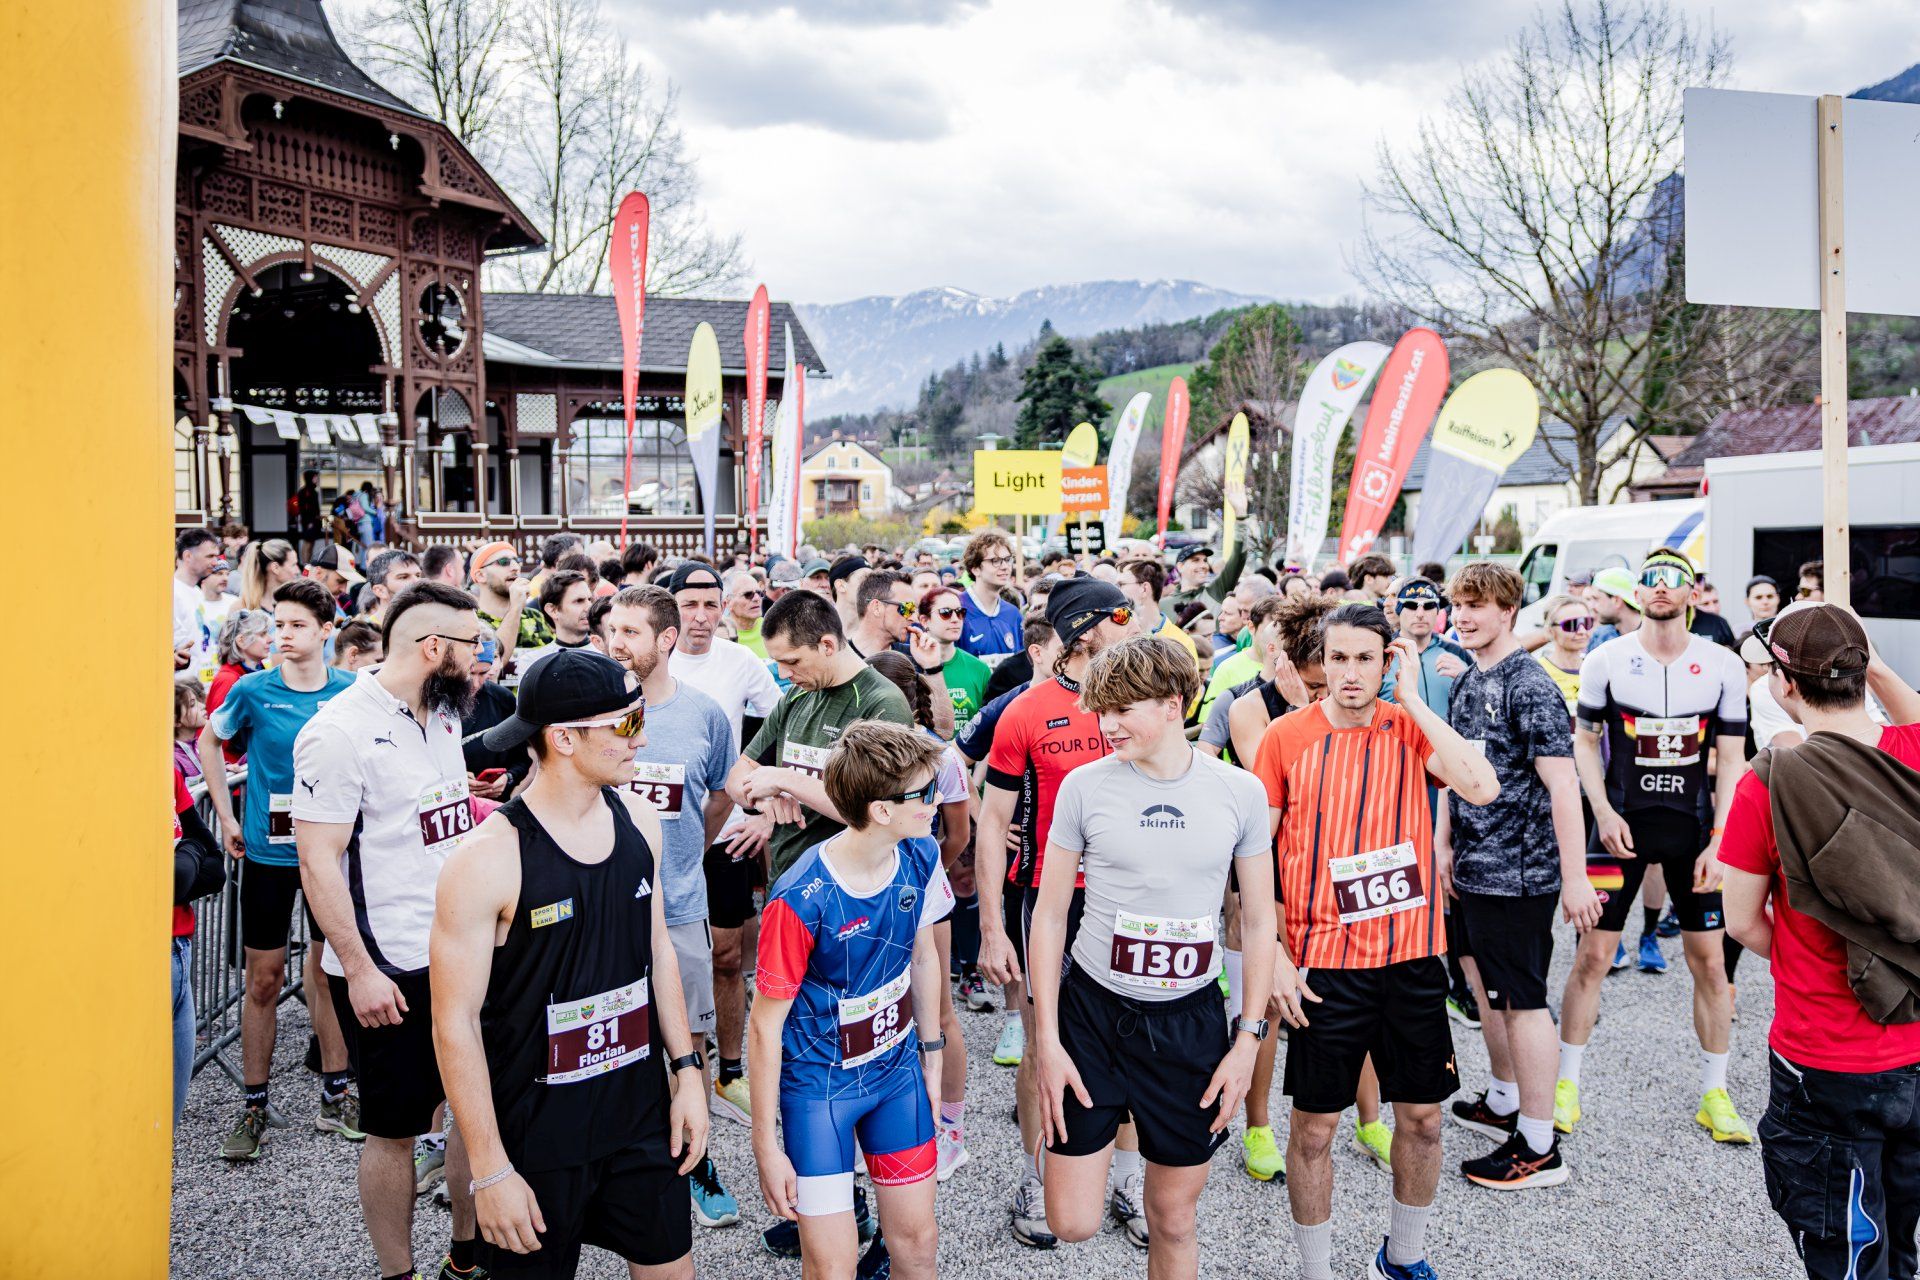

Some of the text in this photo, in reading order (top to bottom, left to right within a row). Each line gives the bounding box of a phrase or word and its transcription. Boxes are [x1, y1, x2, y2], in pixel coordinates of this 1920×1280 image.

[1378, 348, 1426, 462] MeinBezirk.at
[1448, 420, 1497, 448] Raiffeisen
[993, 472, 1045, 491] Light
[1061, 476, 1103, 489] Kinder-
[1070, 526, 1101, 538] Nodic
[1048, 719, 1069, 728] d-race
[1041, 738, 1084, 754] TOUR
[1657, 735, 1684, 751] 84
[1640, 773, 1686, 794] GER
[430, 802, 470, 839] 178
[1020, 806, 1031, 832] Herz
[1139, 818, 1186, 829] skinfit
[1021, 834, 1030, 870] Verein
[801, 877, 823, 900] DNA
[1347, 869, 1411, 909] 166
[534, 906, 554, 916] SPORT
[536, 917, 553, 925] LAND
[1127, 942, 1198, 977] 130
[872, 1003, 899, 1035] 68
[587, 1016, 619, 1050] 81
[873, 1027, 899, 1048] Felix
[579, 1044, 626, 1068] Florian
